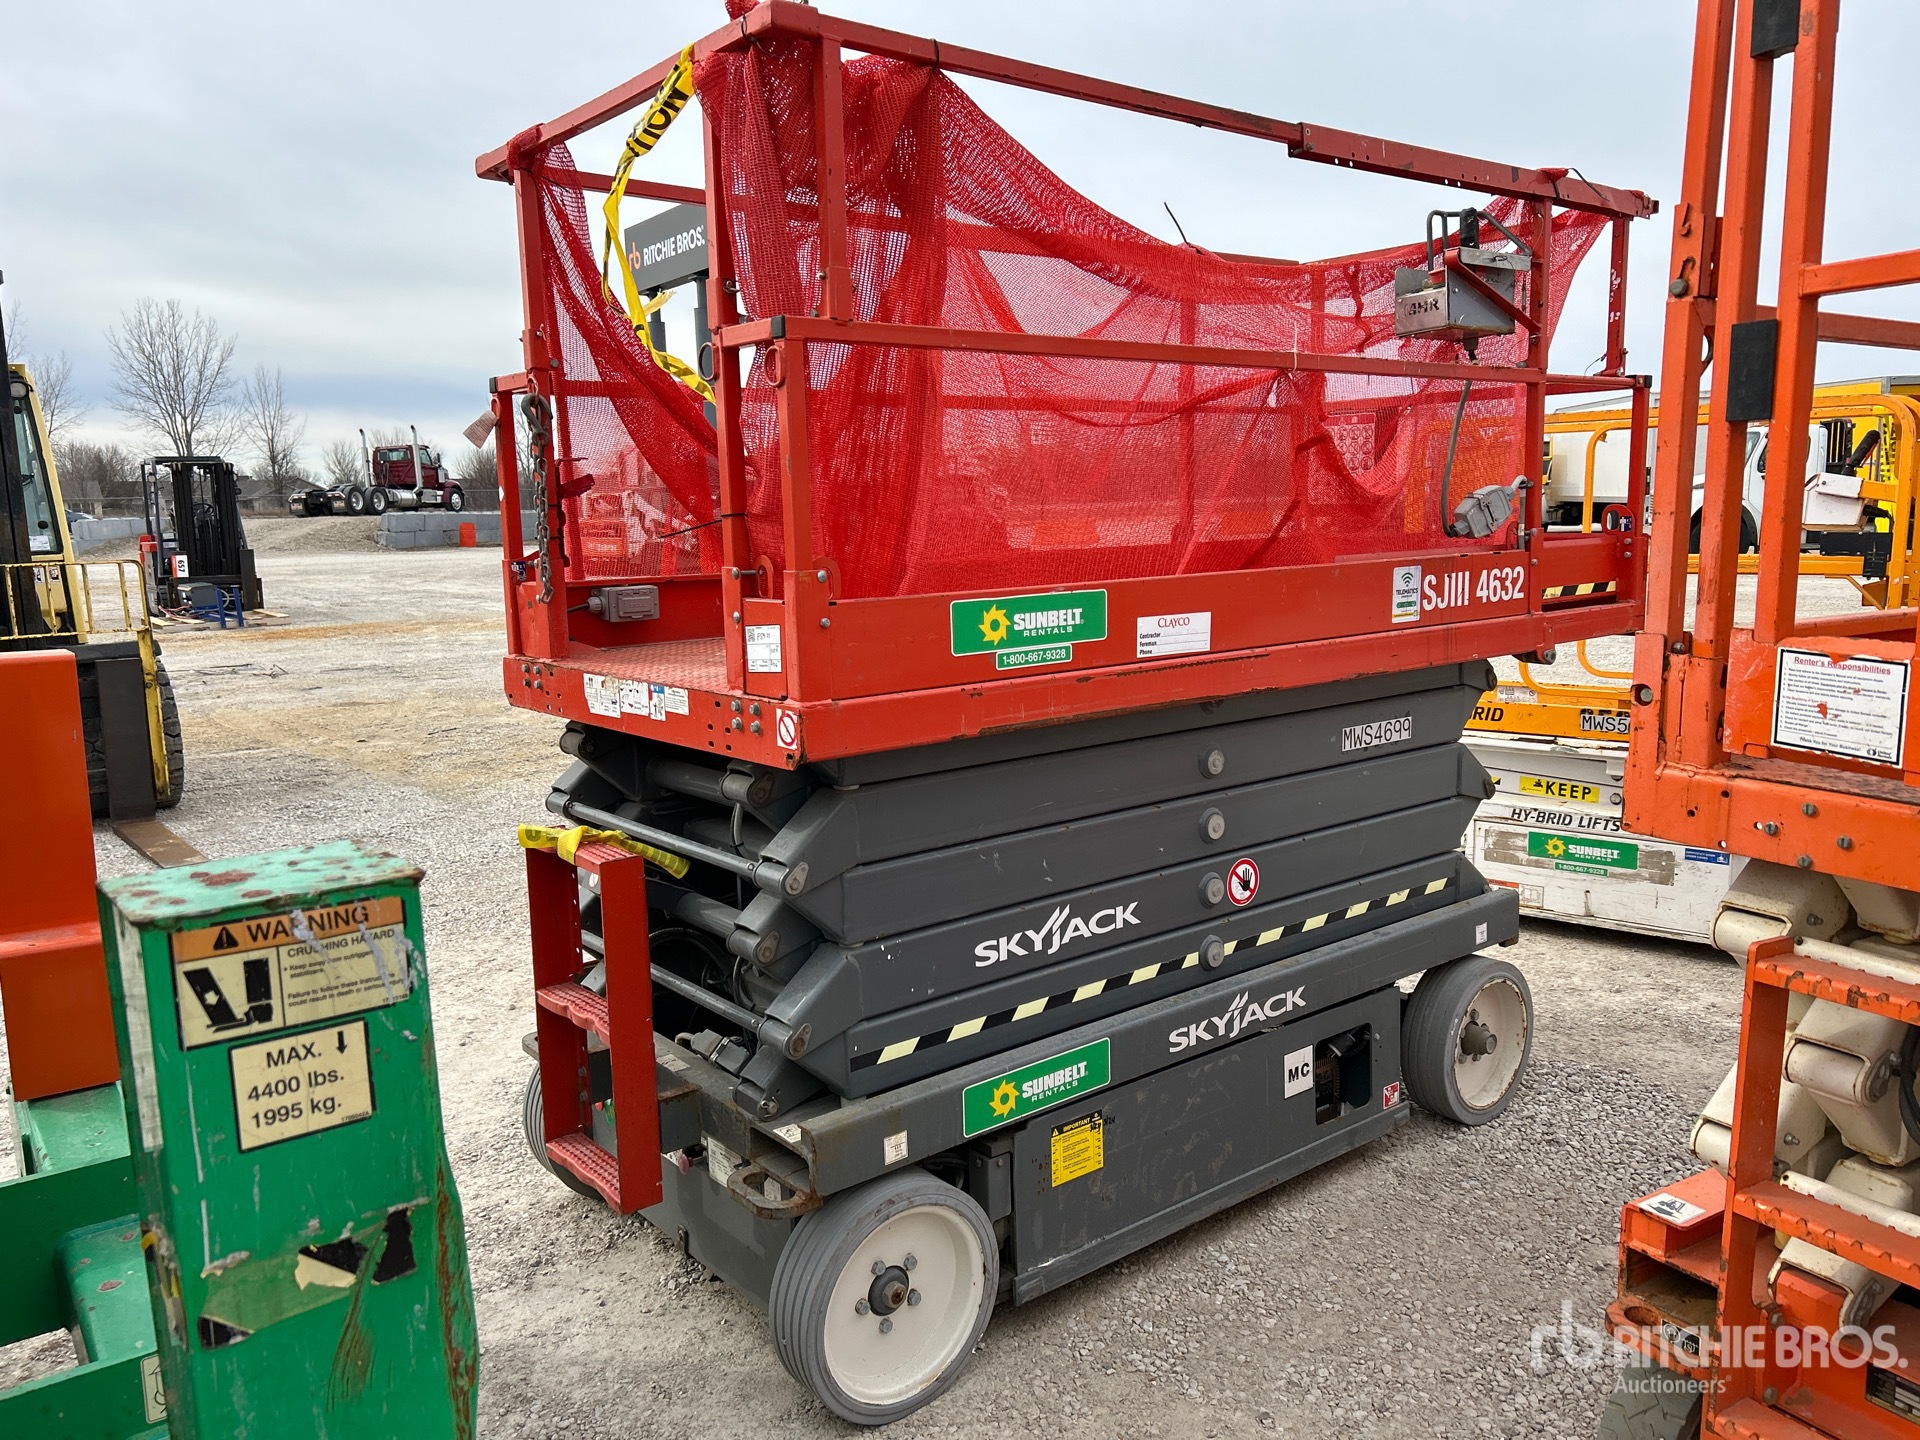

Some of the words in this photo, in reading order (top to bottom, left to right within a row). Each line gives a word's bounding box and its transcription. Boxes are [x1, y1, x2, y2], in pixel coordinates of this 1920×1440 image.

[643, 236, 676, 266] RITCHIE
[178, 560, 186, 572] 657
[1476, 566, 1525, 604] 4632
[1014, 608, 1083, 630] SUNBELT
[1158, 616, 1190, 628] CLAYCO
[1024, 626, 1073, 637] RENTALS
[1002, 648, 1066, 665] 1-800-667-9328
[1794, 656, 1825, 668] Renter's
[1828, 661, 1891, 675] Responsibilities
[1469, 706, 1504, 722] RID
[1582, 715, 1630, 732] MWS5
[1344, 718, 1411, 750] MWS4699
[1546, 780, 1592, 800] KEEP
[1511, 808, 1573, 827] HY-BRID
[1578, 816, 1622, 832] LIFTS
[1568, 844, 1620, 859] SUNBELT
[1574, 854, 1612, 862] RENTALS
[1558, 864, 1604, 875] 1-800-667-9328
[247, 906, 369, 942] WANING
[974, 901, 1142, 968] SKYJACK
[351, 928, 395, 946] HAARD
[1168, 986, 1307, 1053] SKYJACK
[266, 1042, 322, 1068] MAX.
[1022, 1061, 1088, 1098] SUNBELT
[1288, 1062, 1310, 1083] MC
[248, 1076, 300, 1102] 4400
[308, 1068, 344, 1088] lbs.
[1032, 1080, 1078, 1102] RENTALS
[252, 1102, 303, 1128] 1995
[310, 1096, 342, 1114] kg.
[1062, 1118, 1090, 1132] IMPORTANT
